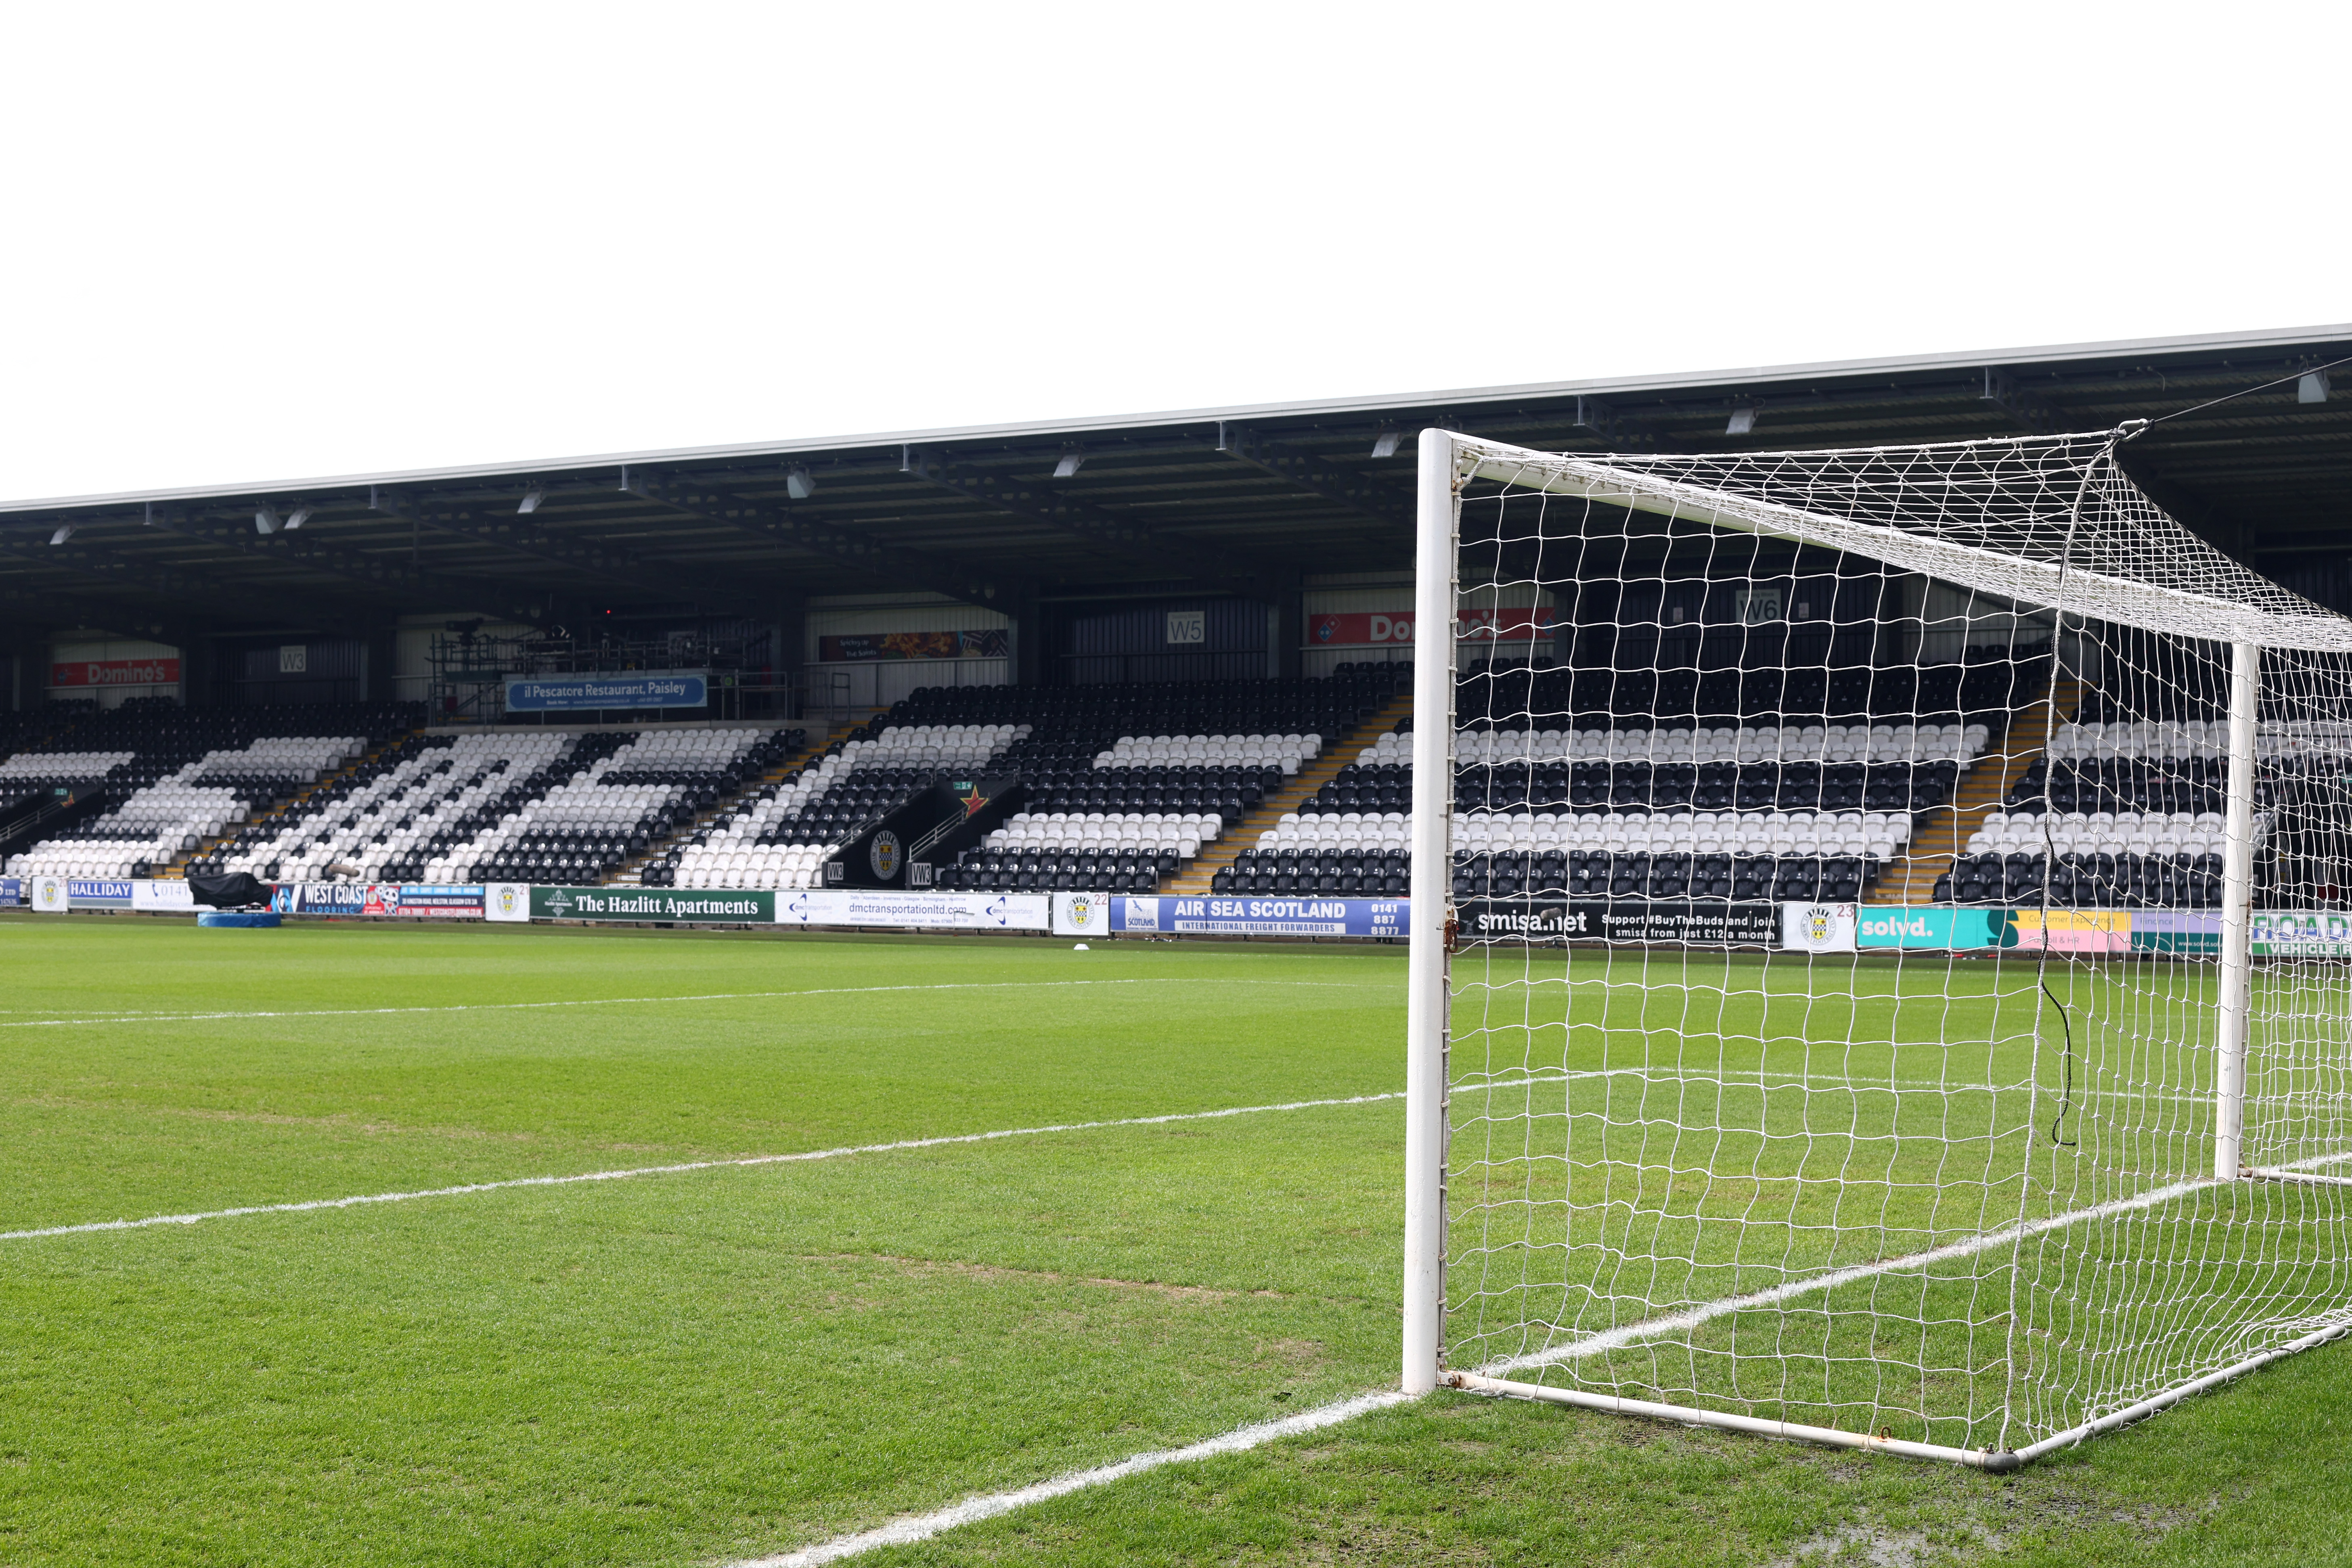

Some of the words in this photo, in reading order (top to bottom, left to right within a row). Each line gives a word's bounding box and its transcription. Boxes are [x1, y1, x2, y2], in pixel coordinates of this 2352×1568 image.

[1740, 599, 1778, 621] W6
[1171, 620, 1201, 641] W5
[1370, 610, 1502, 641] Dono's
[840, 639, 861, 647] Spicing
[282, 653, 304, 670] W3
[88, 660, 165, 683] Domino's
[525, 686, 531, 697] il
[533, 685, 583, 697] Pescatore
[586, 684, 646, 695] Restaurant,
[649, 681, 686, 696] Paisley
[913, 865, 930, 883] VW3
[71, 883, 130, 896] HALLIDAY
[161, 886, 188, 896] 0141
[305, 884, 333, 904] WEST
[335, 885, 368, 904] COAST
[519, 885, 530, 895] 21
[576, 894, 604, 912] The
[608, 896, 661, 913] Hazlitt
[665, 897, 758, 917] Apartments
[1094, 894, 1107, 905] 22
[306, 906, 354, 914] FLOORING
[850, 903, 966, 915] dmctransportationltd.com
[1175, 900, 1204, 916] AIR
[1211, 901, 1245, 917] SEA
[1250, 902, 1346, 918] SCOTLAND
[1371, 904, 1397, 913] 0141
[1837, 905, 1854, 917] 23
[1128, 918, 1155, 926] SCOTLAND
[1374, 915, 1395, 924] 887
[1478, 909, 1587, 932] smisa.net
[1602, 914, 1645, 925] Support
[1649, 915, 1723, 926] #BuyTheBuds
[1728, 917, 1748, 925] and
[1754, 917, 1775, 927] join
[1182, 922, 1243, 930] INTERNATIONAL
[1281, 923, 1335, 932] FORWARDERS
[1371, 926, 1399, 935] 8877
[1862, 917, 1933, 937] solvd.
[1616, 928, 1646, 937] smisa
[1650, 928, 1675, 937] from
[1680, 929, 1701, 939] just
[1705, 929, 1723, 938] £12
[1738, 931, 1775, 940] month
[2269, 944, 2338, 954] VEHICLE
